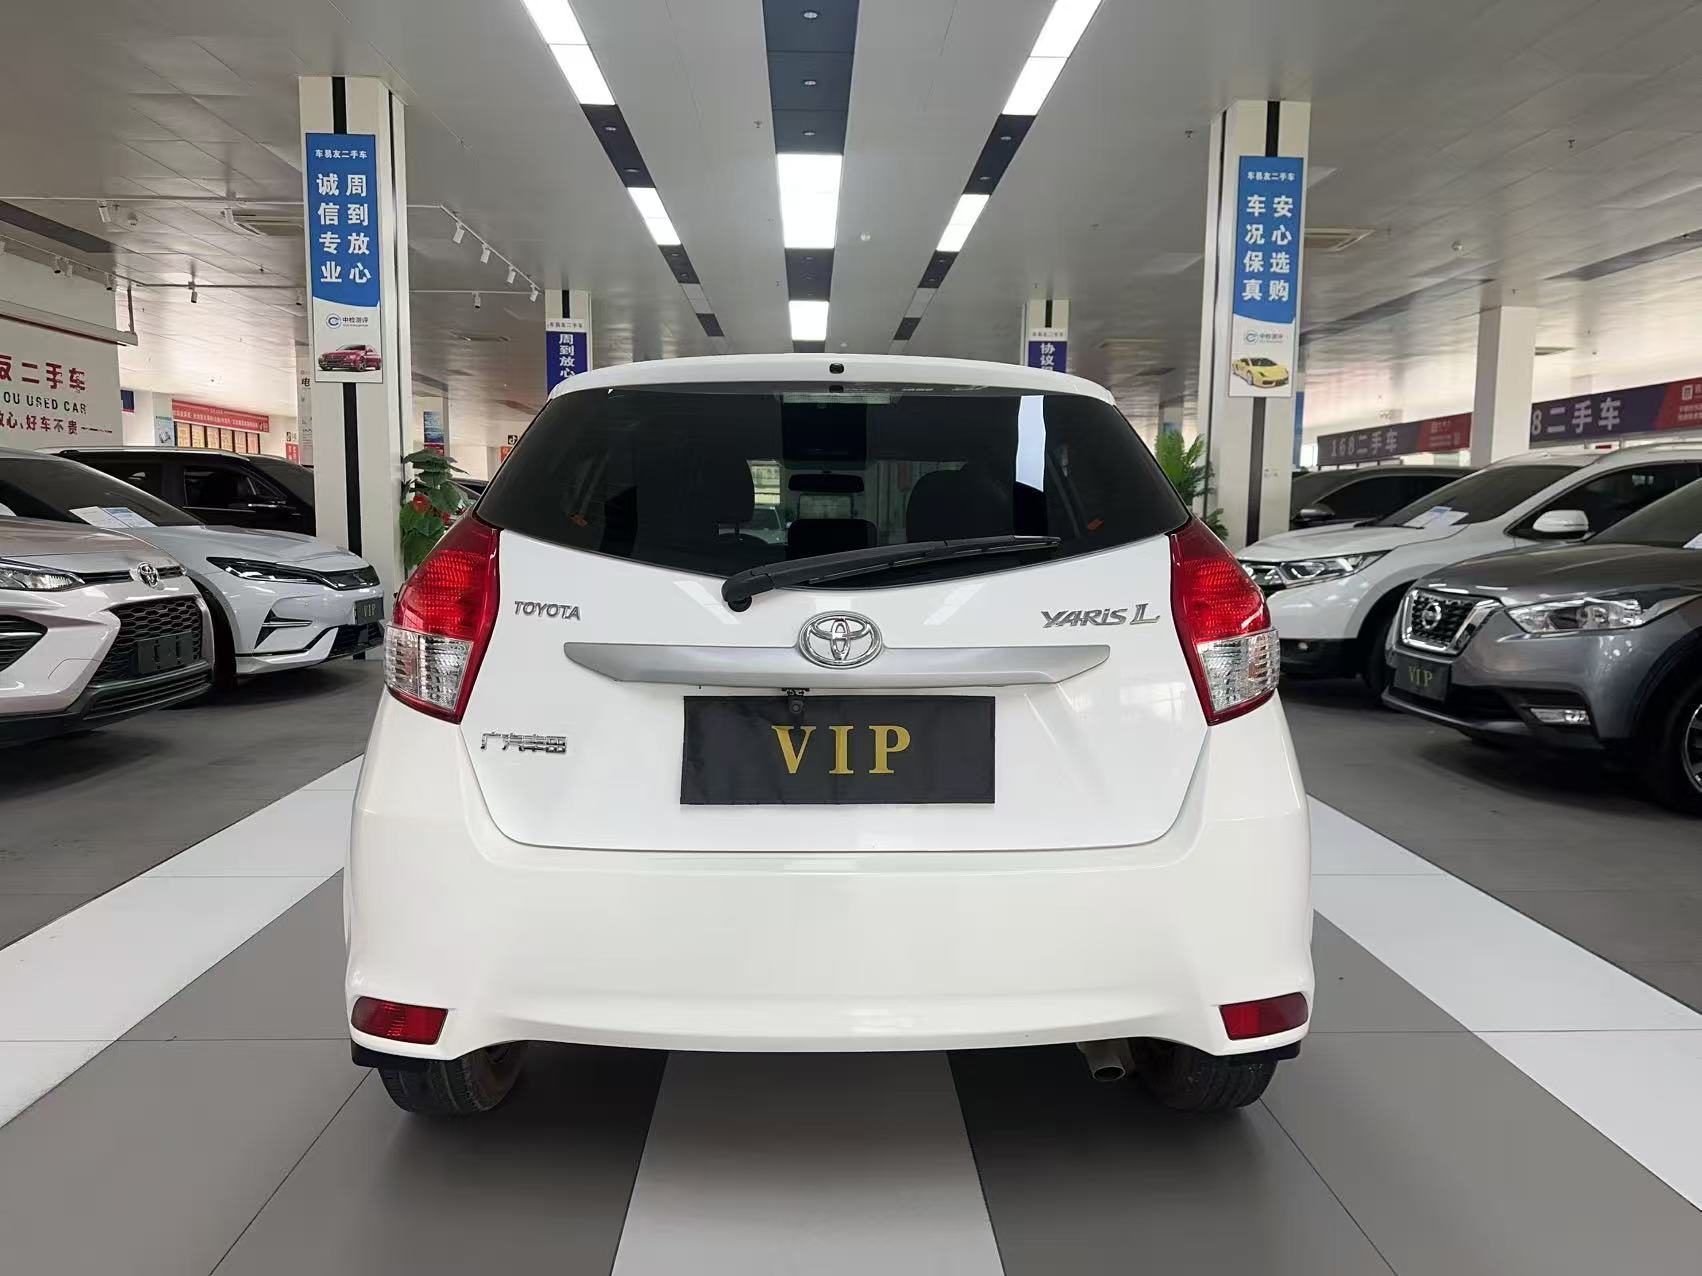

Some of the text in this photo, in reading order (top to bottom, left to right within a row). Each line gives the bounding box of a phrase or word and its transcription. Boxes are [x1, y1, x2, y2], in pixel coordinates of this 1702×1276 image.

[316, 173, 342, 283] 诚信专业
[345, 174, 372, 284] 周到放心
[1241, 194, 1266, 301] 车况保真
[1268, 194, 1293, 302] 安心选购
[559, 333, 575, 378] 周到放心
[26, 395, 59, 410] USED
[63, 400, 87, 415] CAR
[1331, 428, 1399, 457] 168二手车
[514, 600, 581, 621] TOYOTA
[1407, 665, 1434, 688] VIP
[771, 725, 911, 774] VIP
